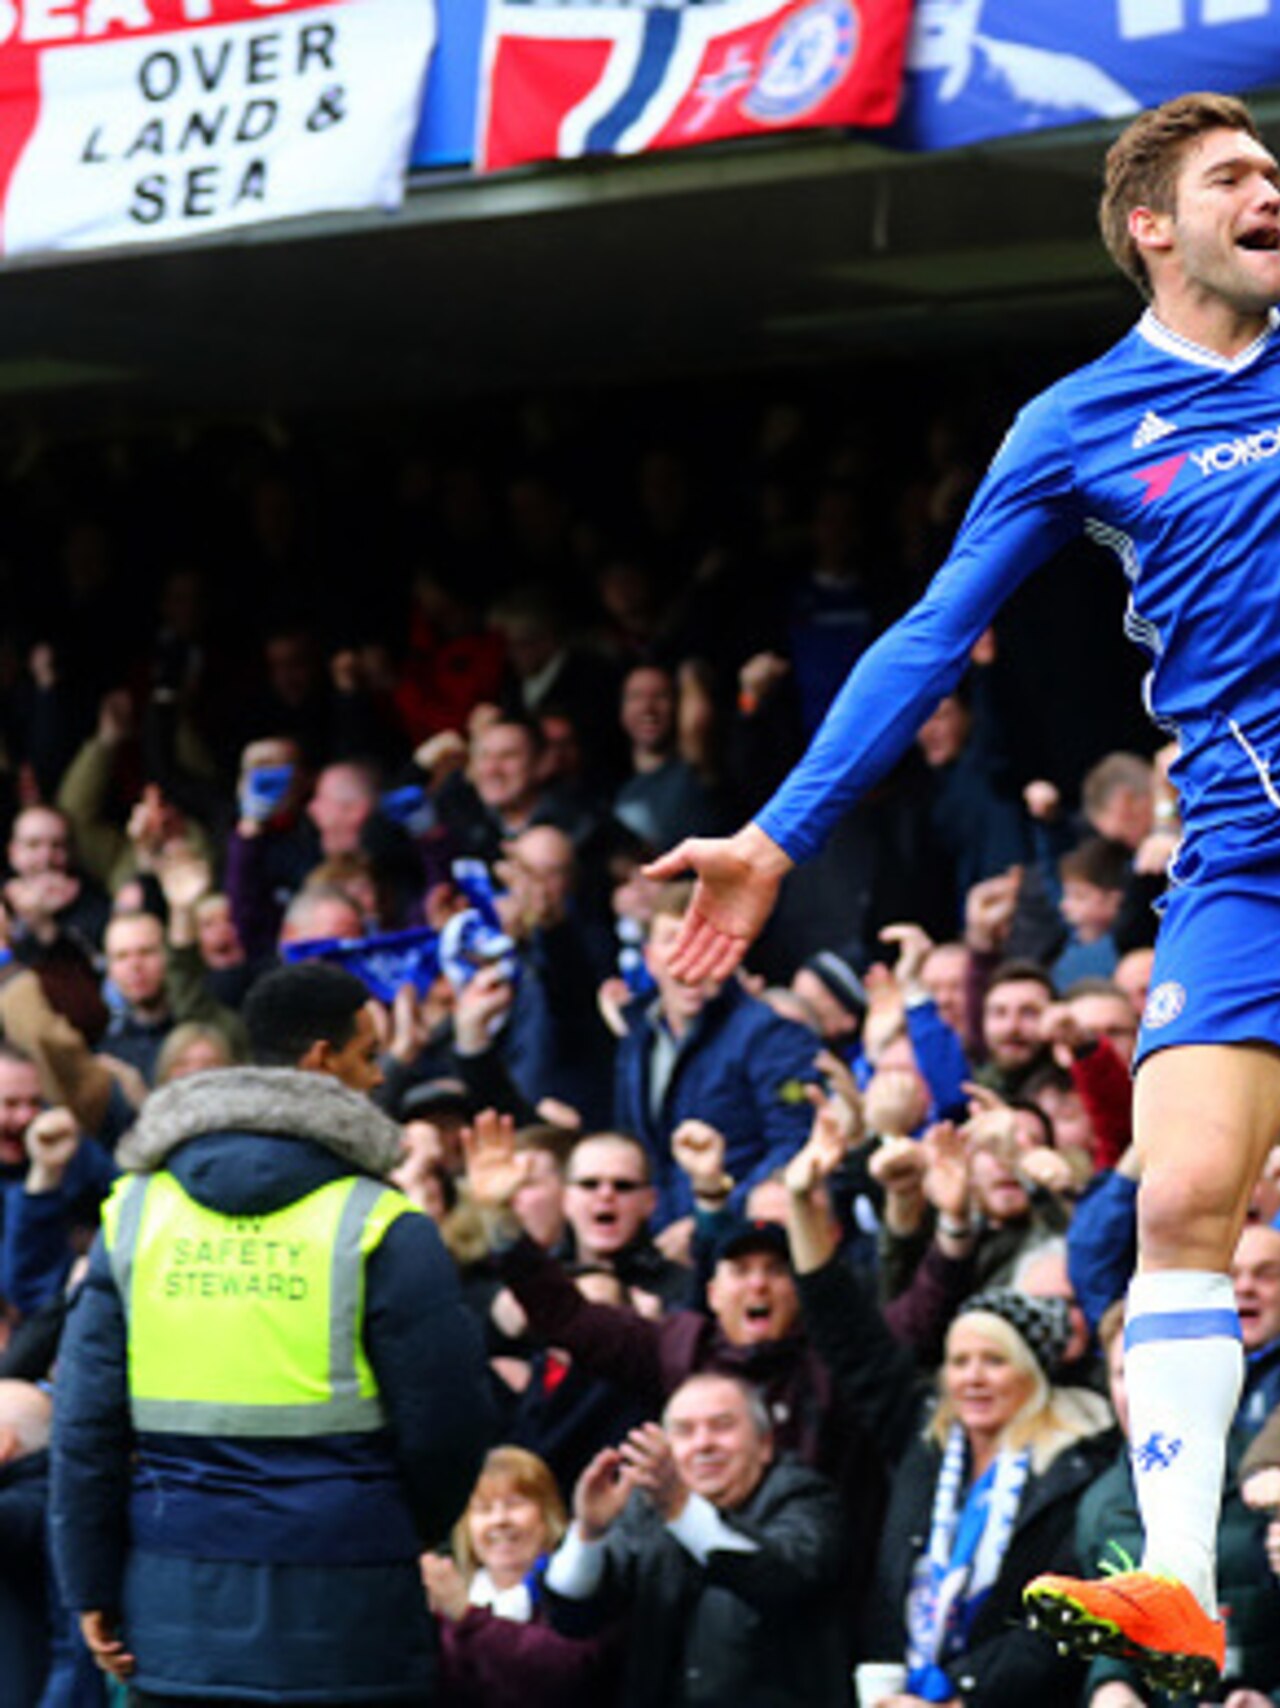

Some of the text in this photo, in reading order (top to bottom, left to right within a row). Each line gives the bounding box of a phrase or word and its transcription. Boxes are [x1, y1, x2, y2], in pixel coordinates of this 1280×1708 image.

[138, 22, 335, 102] OVER
[81, 85, 345, 163] LAND &
[129, 158, 266, 225] SEA
[174, 1237, 306, 1267] SAFETY
[165, 1272, 309, 1300] STEWARD
